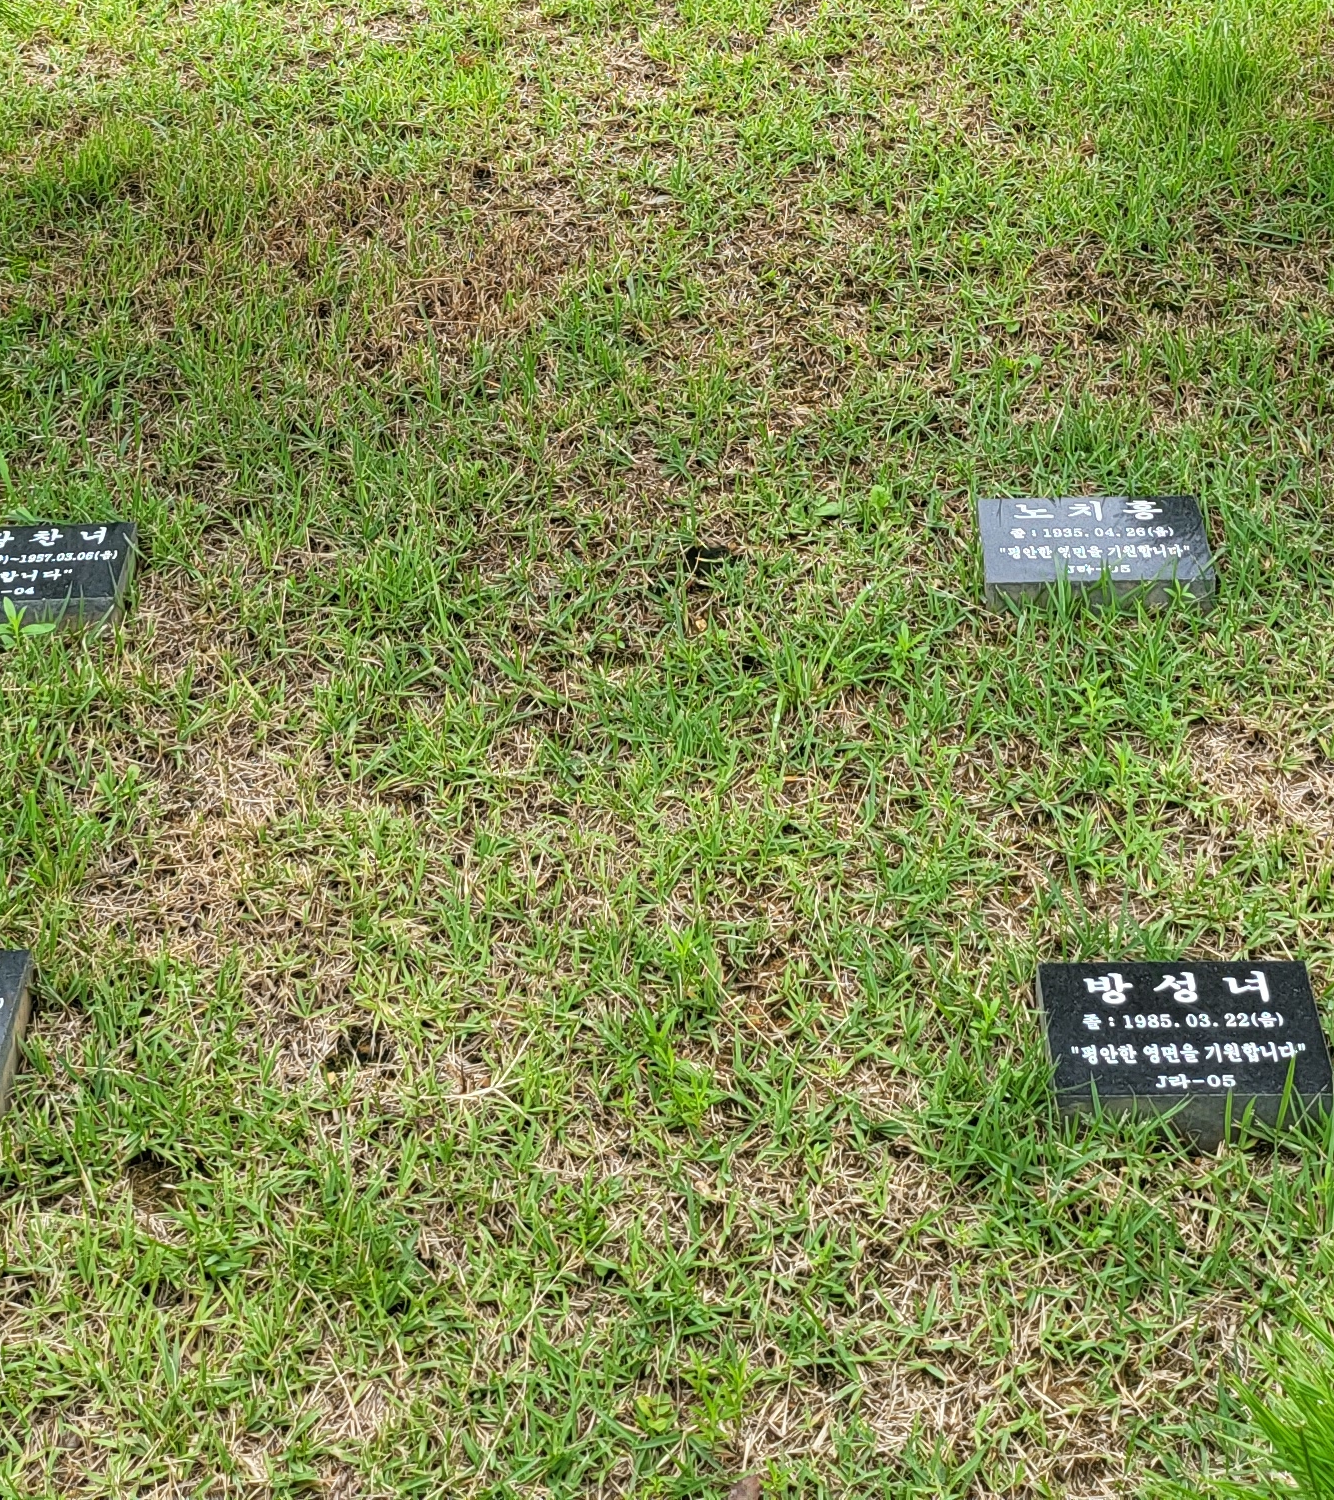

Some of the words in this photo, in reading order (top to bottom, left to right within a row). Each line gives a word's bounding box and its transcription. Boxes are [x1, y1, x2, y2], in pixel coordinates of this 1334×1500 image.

[1071, 1043, 1137, 1065] "평안한
[1142, 1042, 1200, 1064] 영면을
[1204, 1041, 1306, 1064] 기원합니다"
[1155, 1073, 1237, 1089] J라-05
